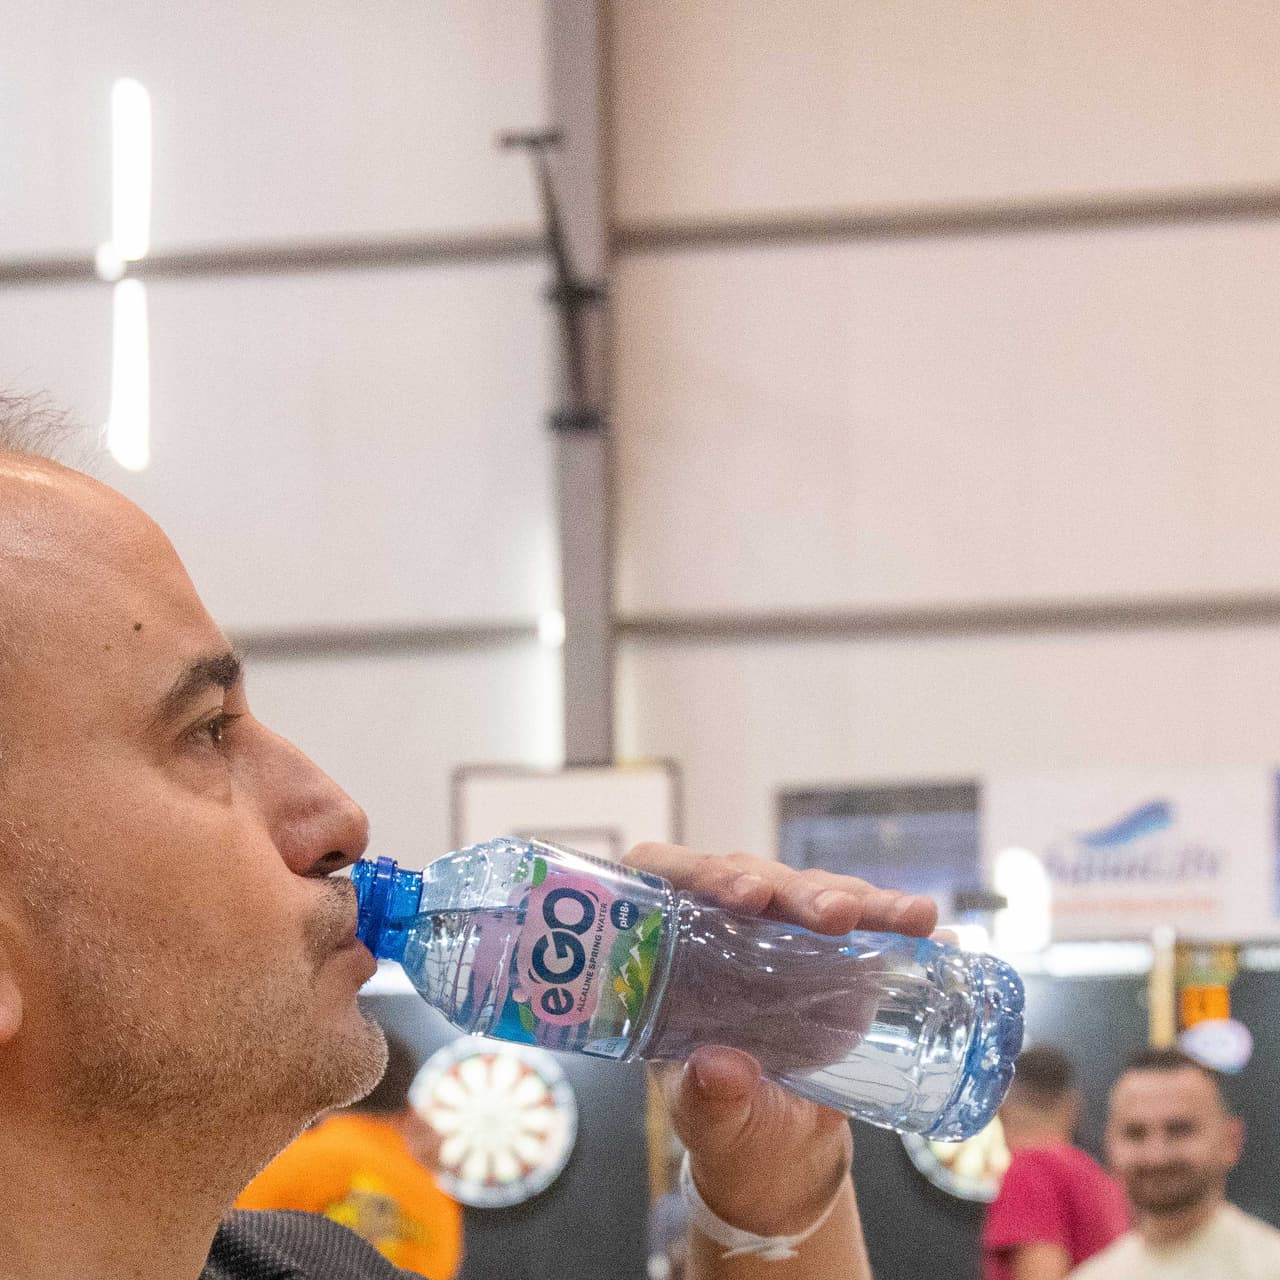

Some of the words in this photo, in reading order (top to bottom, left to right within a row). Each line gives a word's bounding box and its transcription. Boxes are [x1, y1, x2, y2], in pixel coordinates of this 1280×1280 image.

[588, 934, 602, 970] SPRING
[596, 902, 608, 933] WATER
[618, 901, 630, 928] pH8+
[531, 887, 596, 1016] eGO
